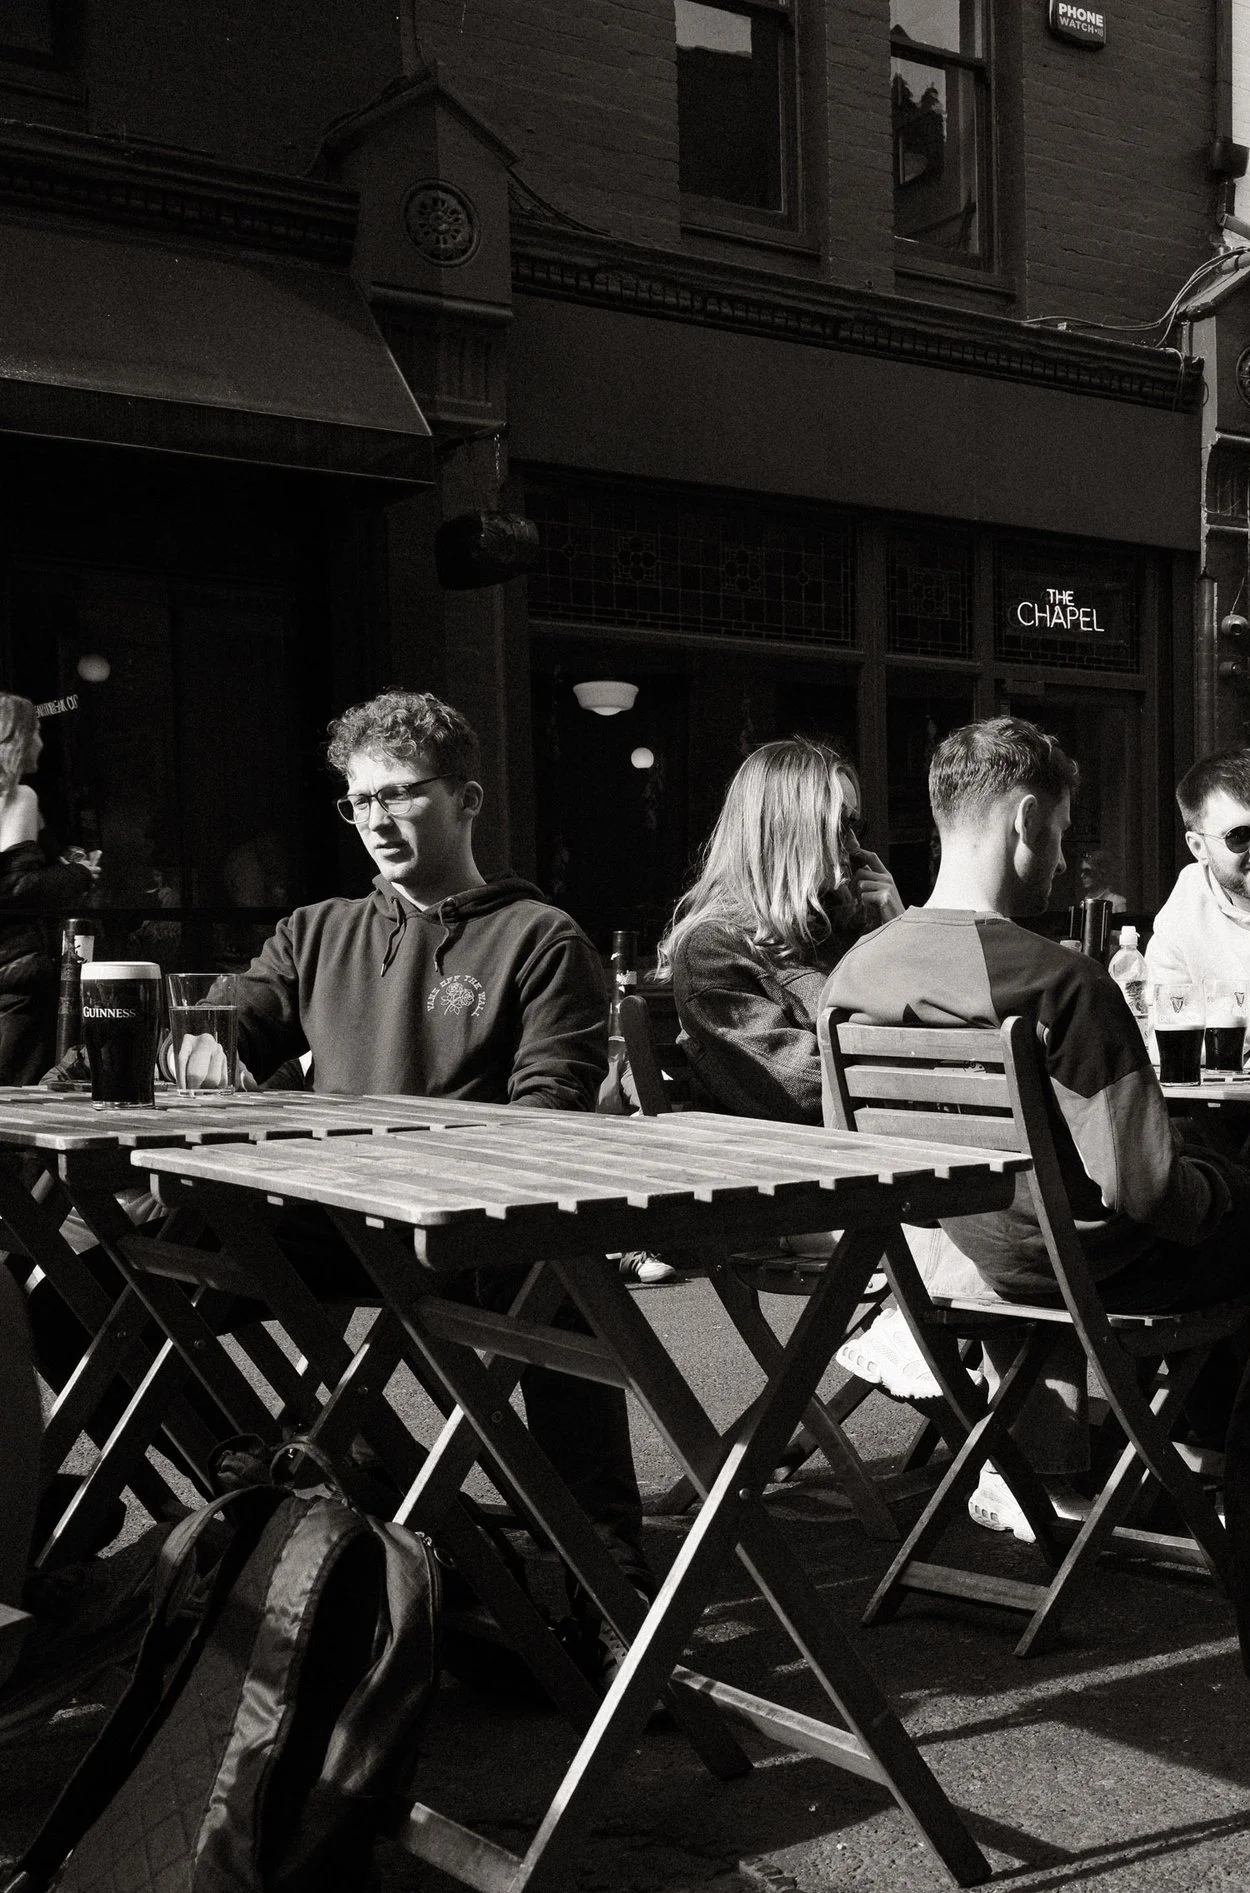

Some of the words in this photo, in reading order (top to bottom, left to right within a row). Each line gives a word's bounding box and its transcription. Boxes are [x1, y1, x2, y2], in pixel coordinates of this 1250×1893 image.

[1058, 2, 1104, 28] PHONE
[1059, 16, 1094, 34] WATCH
[1046, 588, 1075, 606] THE
[1017, 601, 1105, 632] CHAPEL
[440, 975, 461, 988] OFF
[463, 974, 482, 990] THE
[83, 1006, 136, 1018] GUINNESS
[470, 991, 487, 1017] WALL
